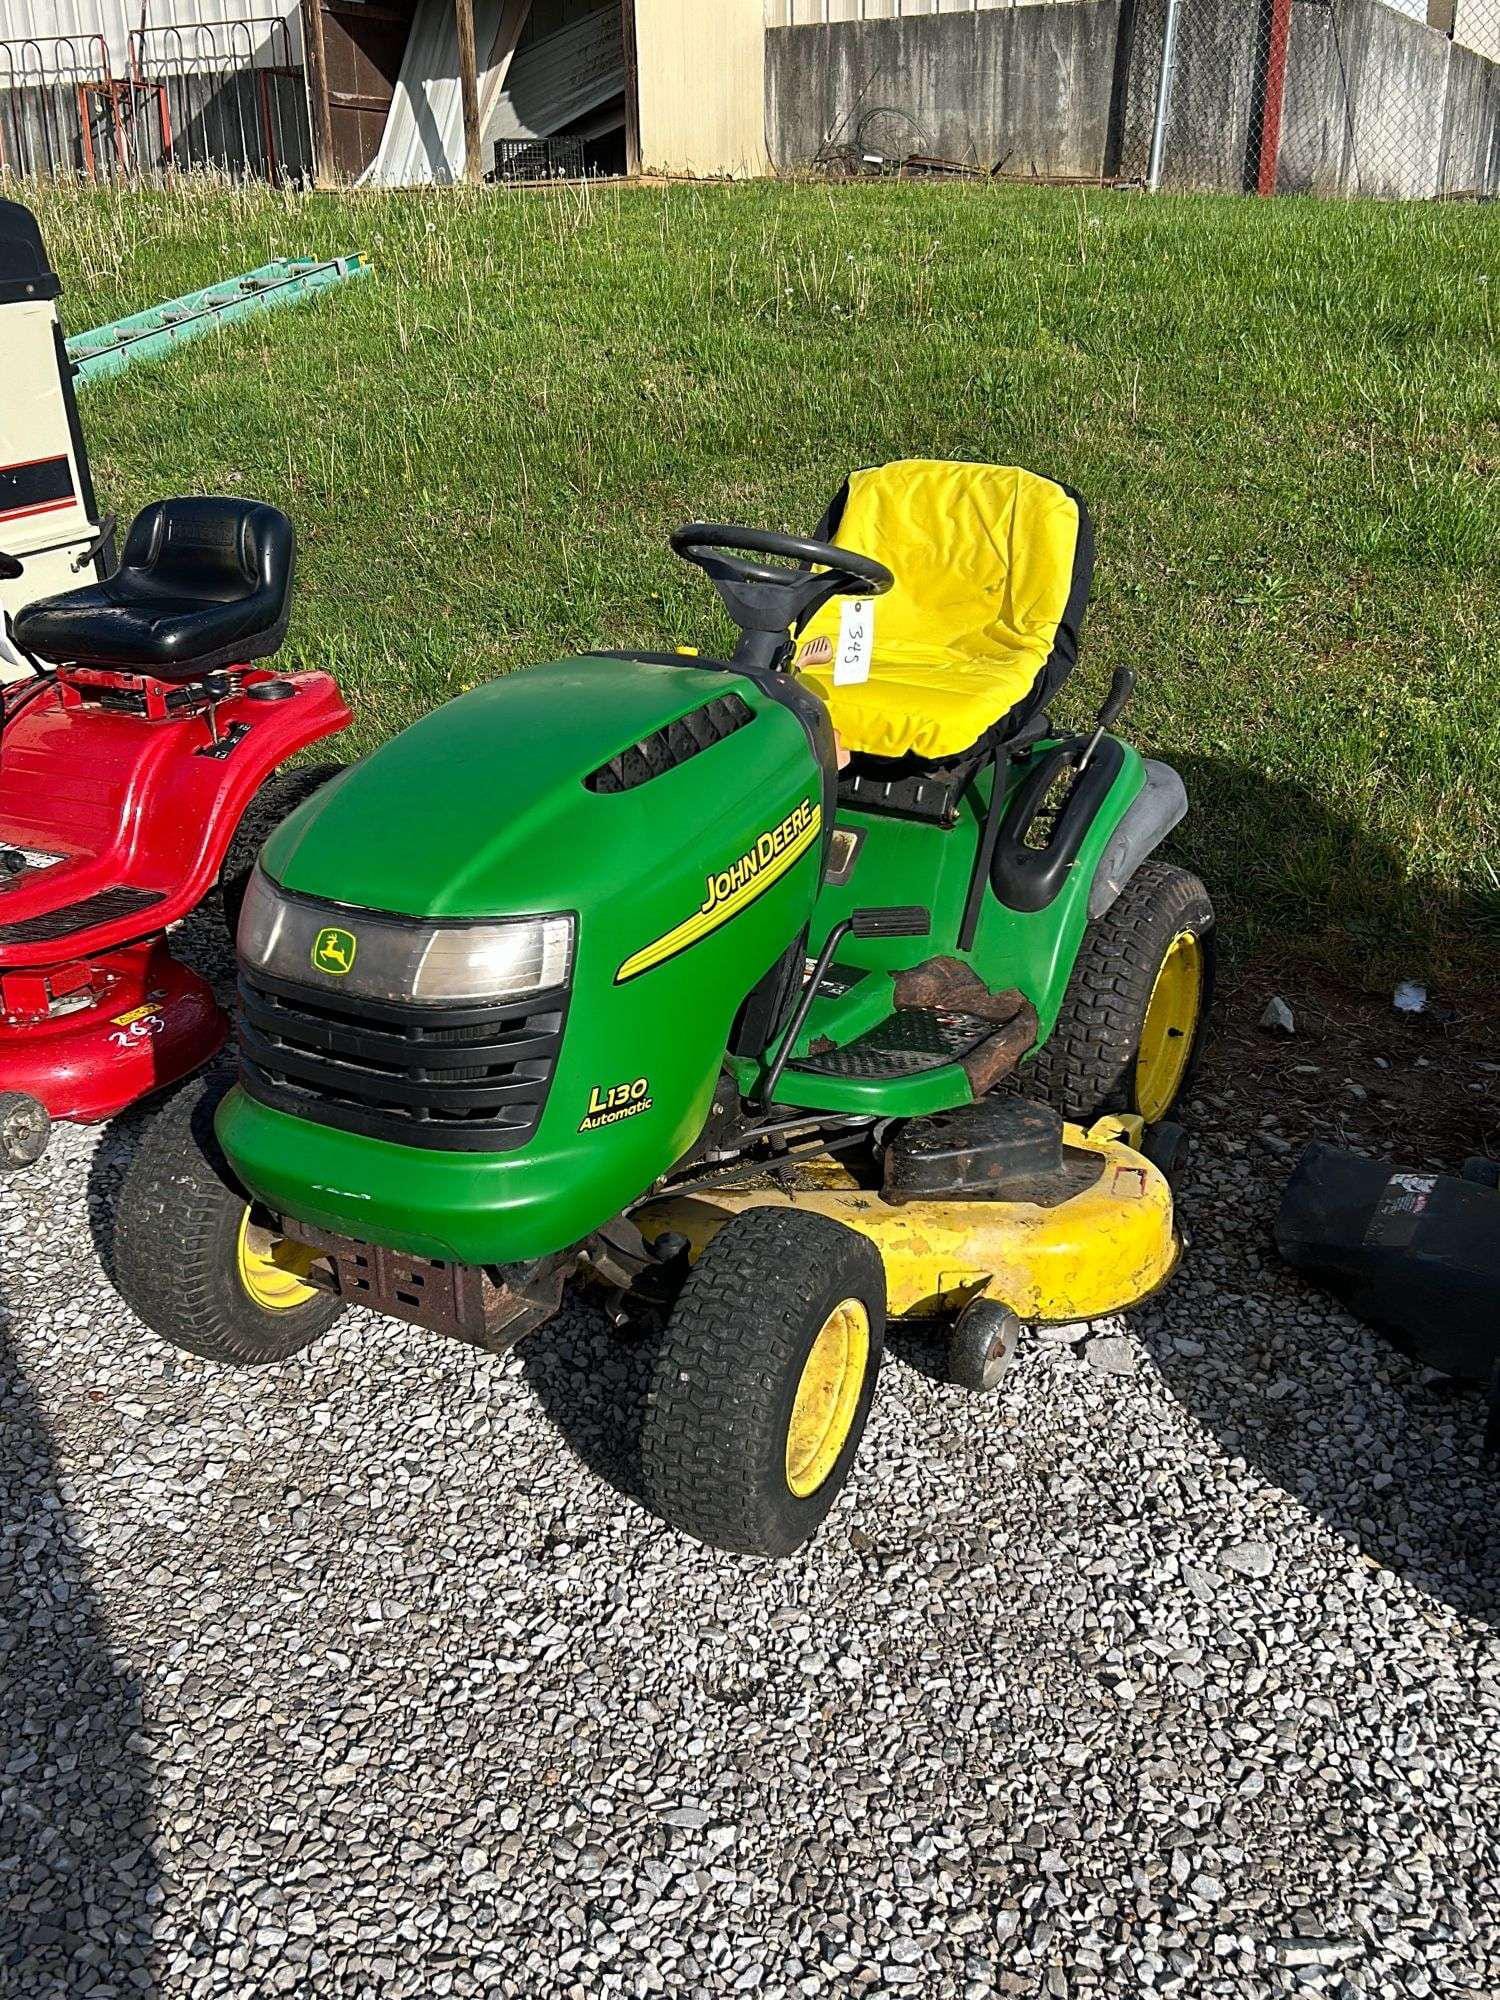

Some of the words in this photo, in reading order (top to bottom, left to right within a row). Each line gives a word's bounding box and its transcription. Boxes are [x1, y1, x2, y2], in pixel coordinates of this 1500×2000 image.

[844, 625, 864, 664] 345
[108, 1015, 165, 1048] 263
[588, 1077, 649, 1114] L130
[578, 1098, 653, 1132] Automatic
